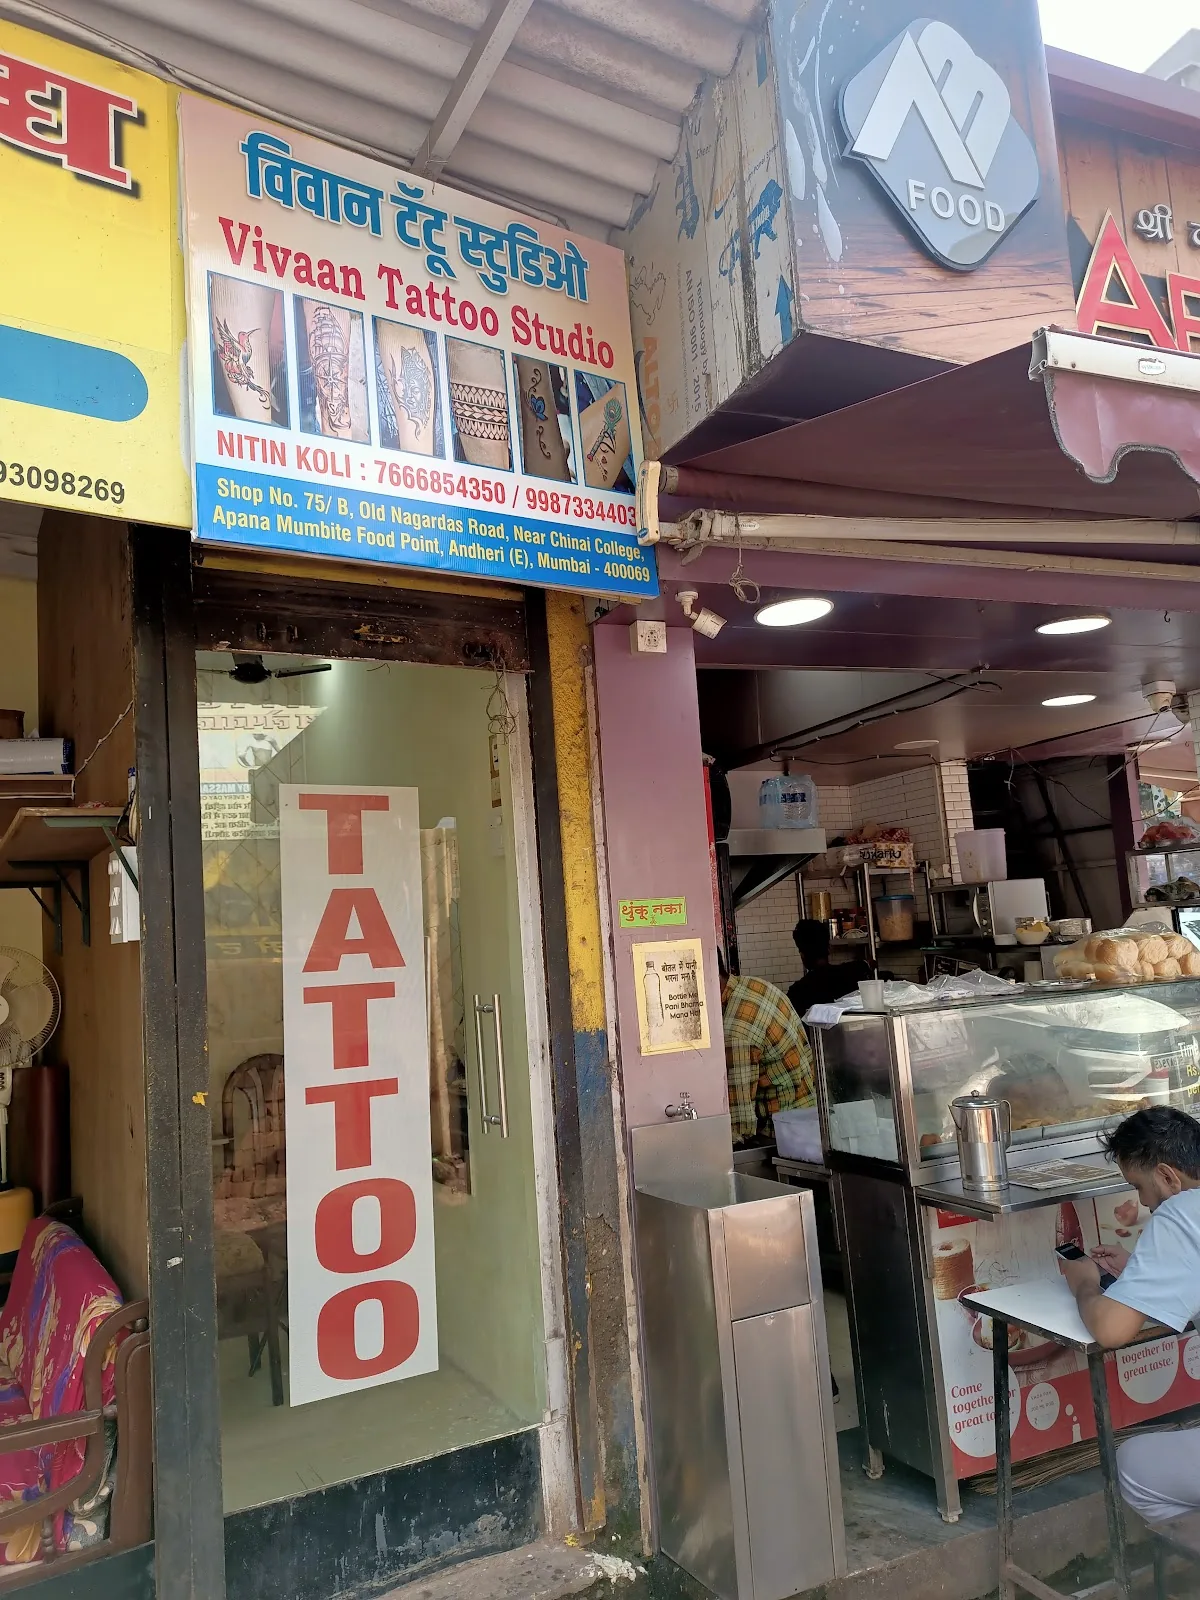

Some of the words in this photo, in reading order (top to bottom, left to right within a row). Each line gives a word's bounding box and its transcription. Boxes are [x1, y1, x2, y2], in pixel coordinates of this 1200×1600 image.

[240, 131, 385, 237] विवान
[389, 180, 456, 280] टॅटू
[452, 215, 589, 303] स्टुडिओ
[907, 179, 1005, 232] FOOD
[1131, 203, 1174, 244] श्री
[218, 216, 365, 301] Vivaan
[378, 263, 499, 337] Tattoo
[511, 305, 614, 369] Studio
[685, 270, 694, 293] AN
[687, 294, 696, 323] ISO
[696, 278, 707, 357] Technology
[689, 325, 699, 361] 9001
[693, 375, 702, 413] 2015
[217, 430, 287, 467] NITIN
[296, 445, 351, 478] KOLI
[374, 460, 506, 505] 7666854350
[512, 485, 519, 508] /
[526, 488, 637, 527] 9987334403
[217, 478, 263, 505] Shop
[269, 486, 298, 508] No.
[304, 492, 331, 514] 75/
[338, 497, 354, 519] B,
[360, 501, 386, 521] Old
[391, 506, 464, 532] Nagardas
[468, 517, 510, 542] Road,
[513, 525, 546, 545] Near
[550, 530, 591, 551] Chinai
[594, 537, 645, 562] College,
[213, 505, 270, 531] Apana
[277, 514, 351, 541] Mumbite
[357, 526, 395, 548] Food
[400, 532, 444, 557] Point,
[449, 539, 505, 563] Andheri
[509, 547, 534, 569] (E),
[537, 552, 591, 574] Mumbai
[604, 562, 650, 583] 400069
[621, 902, 649, 922] थुंकू
[652, 902, 683, 916] नका
[661, 962, 676, 972] बोतल
[665, 973, 679, 982] भरना
[670, 1011, 689, 1019] Mana
[298, 793, 419, 1380] TATTOO
[1121, 1344, 1160, 1364] together
[1162, 1340, 1175, 1352] for
[1123, 1364, 1148, 1382] great
[1149, 1357, 1174, 1371] taste.
[951, 1382, 983, 1399] Come
[953, 1395, 995, 1414] togethe
[954, 1415, 984, 1433] great
